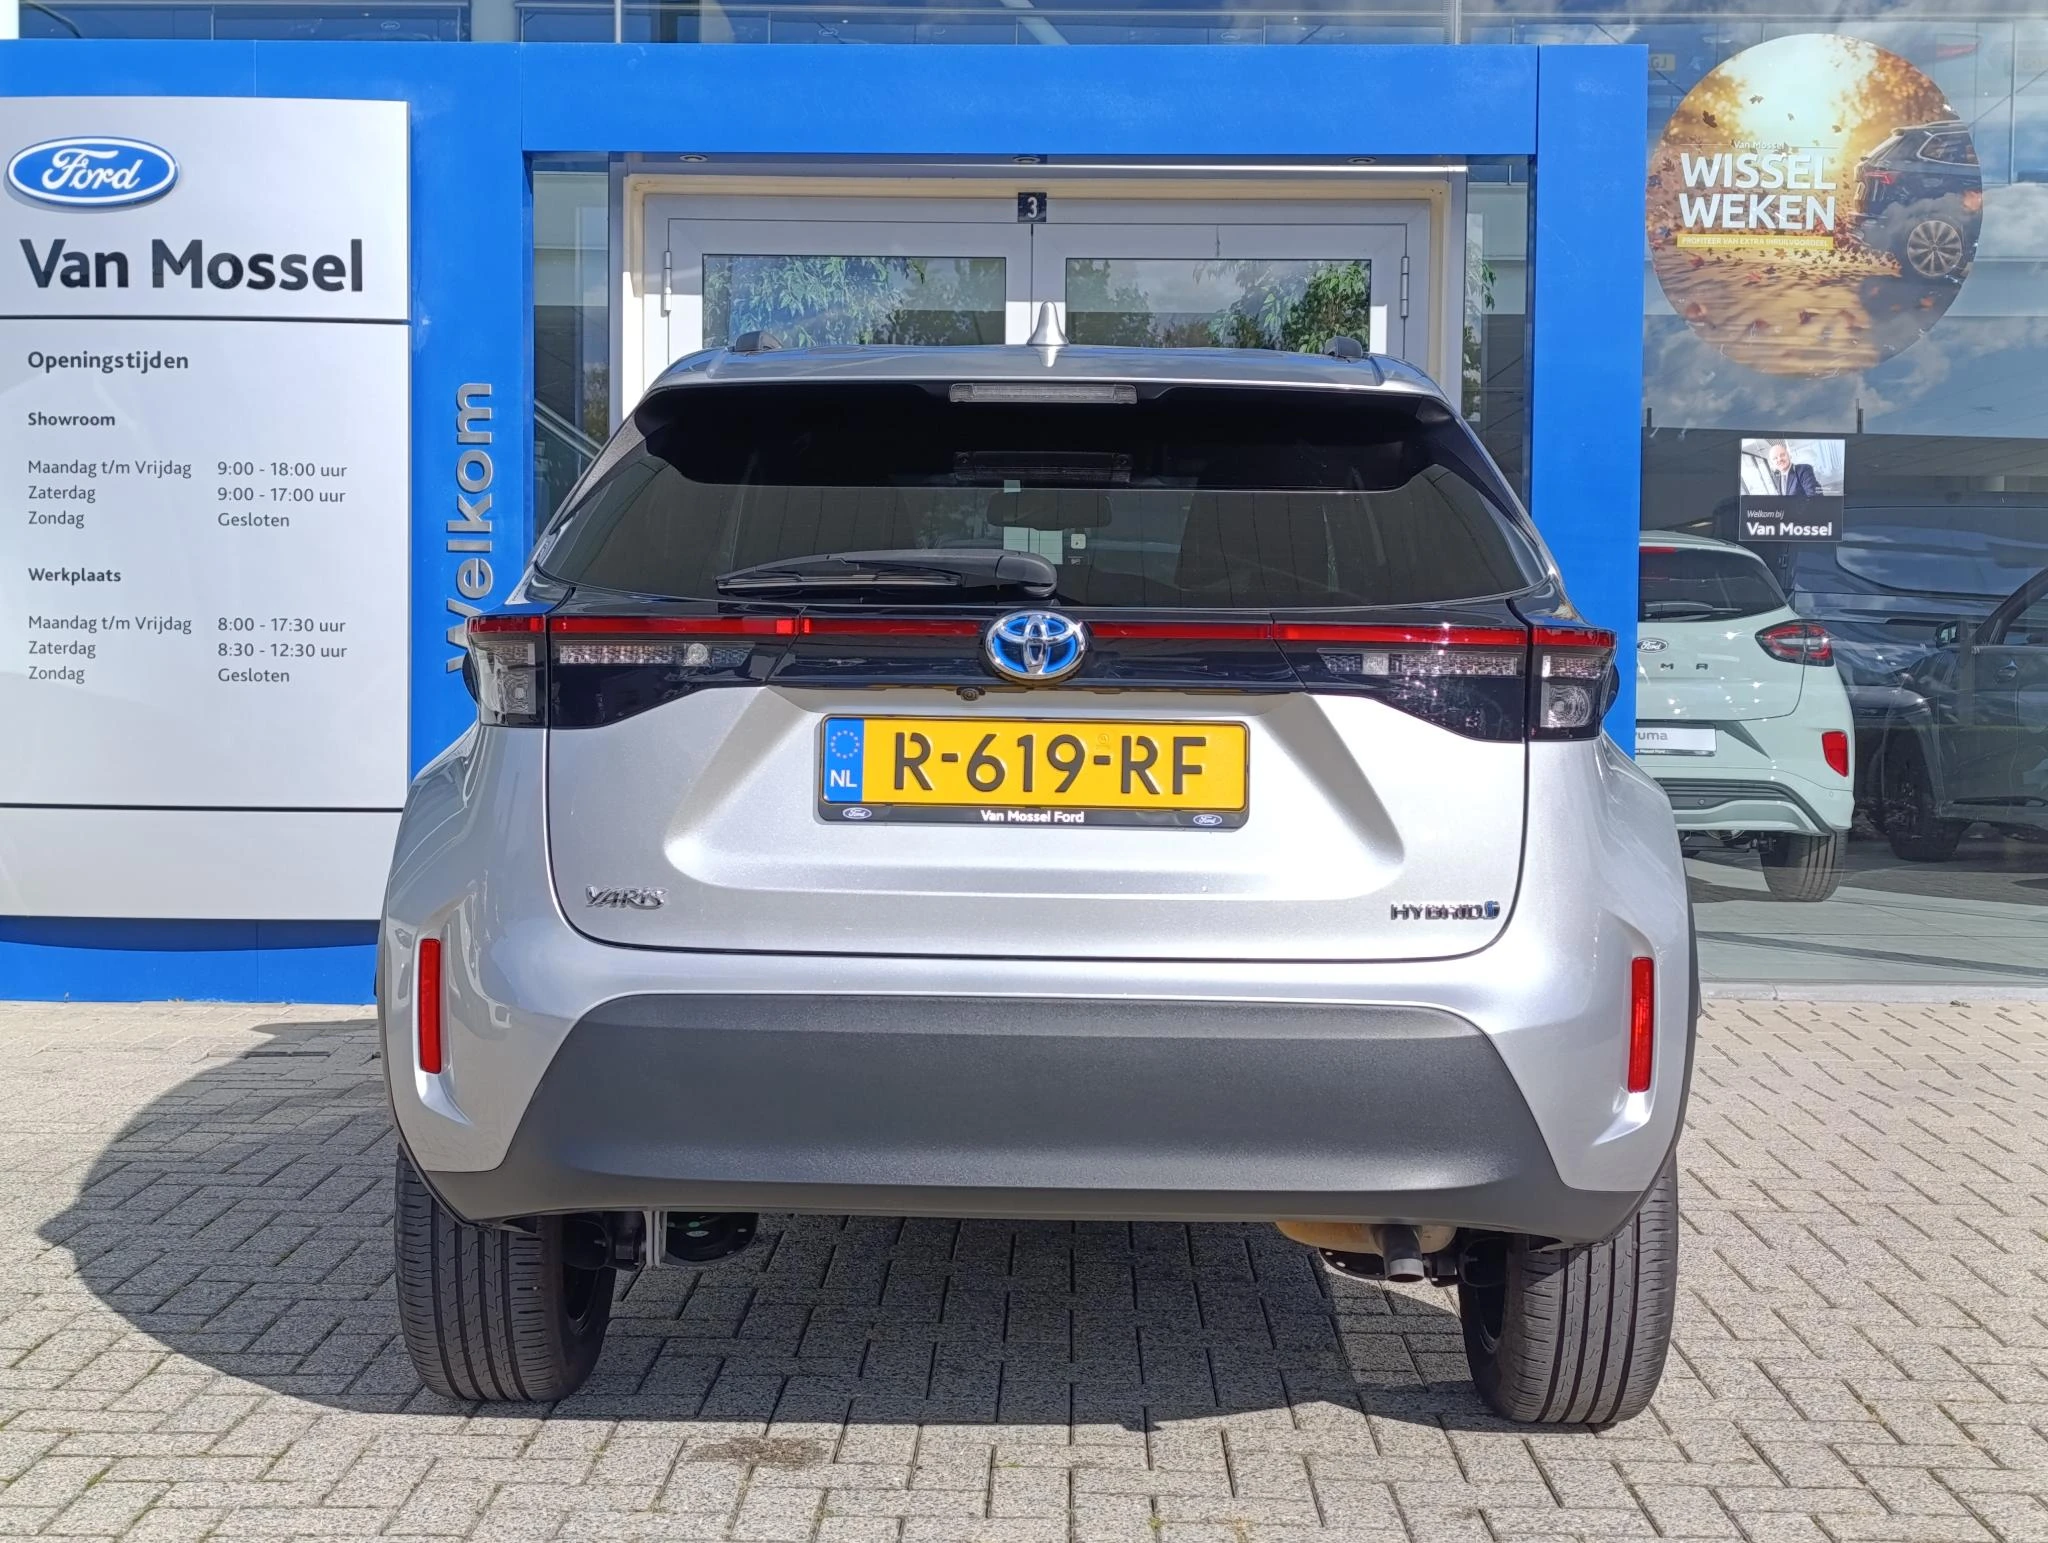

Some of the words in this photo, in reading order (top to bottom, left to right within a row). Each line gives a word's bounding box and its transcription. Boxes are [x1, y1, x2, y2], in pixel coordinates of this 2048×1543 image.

[42, 147, 144, 191] Ford
[1680, 153, 1837, 190] WISSEL
[1027, 196, 1038, 218] 3
[1678, 193, 1836, 231] WEKEN
[19, 238, 129, 288] Van
[151, 238, 362, 292] Mossel
[27, 350, 189, 374] Openingstijden
[27, 411, 116, 427] Showroom
[28, 459, 97, 479] Maandag
[101, 459, 131, 475] t/m
[135, 460, 192, 480] Vrijdag
[217, 460, 255, 476] 9:00
[270, 461, 316, 477] 18:00
[320, 466, 347, 478] uur
[28, 485, 96, 504] Zaterdag
[217, 486, 255, 502] 9:00
[270, 487, 315, 503] 17:00
[319, 491, 346, 503] uur
[28, 510, 85, 529] Zondag
[217, 511, 290, 528] Gesloten
[1747, 510, 1775, 519] Welkom
[1775, 510, 1784, 520] bij
[1746, 521, 1776, 536] Van
[1779, 521, 1833, 537] Mossel
[27, 567, 122, 586] Werkplaats
[28, 614, 97, 634] Maandag
[101, 615, 131, 631] t/m
[135, 616, 192, 635] Vrijdag
[217, 616, 255, 632] 8:00
[270, 617, 315, 633] 17:30
[319, 621, 346, 633] uur
[28, 640, 97, 660] Zaterdag
[217, 642, 255, 657] 8:30
[270, 643, 316, 658] 12:30
[320, 647, 347, 658] uur
[28, 665, 85, 684] Zondag
[217, 667, 290, 683] Gesloten
[1634, 732, 1668, 741] uma
[893, 731, 1207, 795] R-619-RF
[830, 769, 858, 788] NL
[981, 809, 1005, 822] Van
[1007, 810, 1051, 823] Mossel
[1054, 811, 1085, 823] Ford
